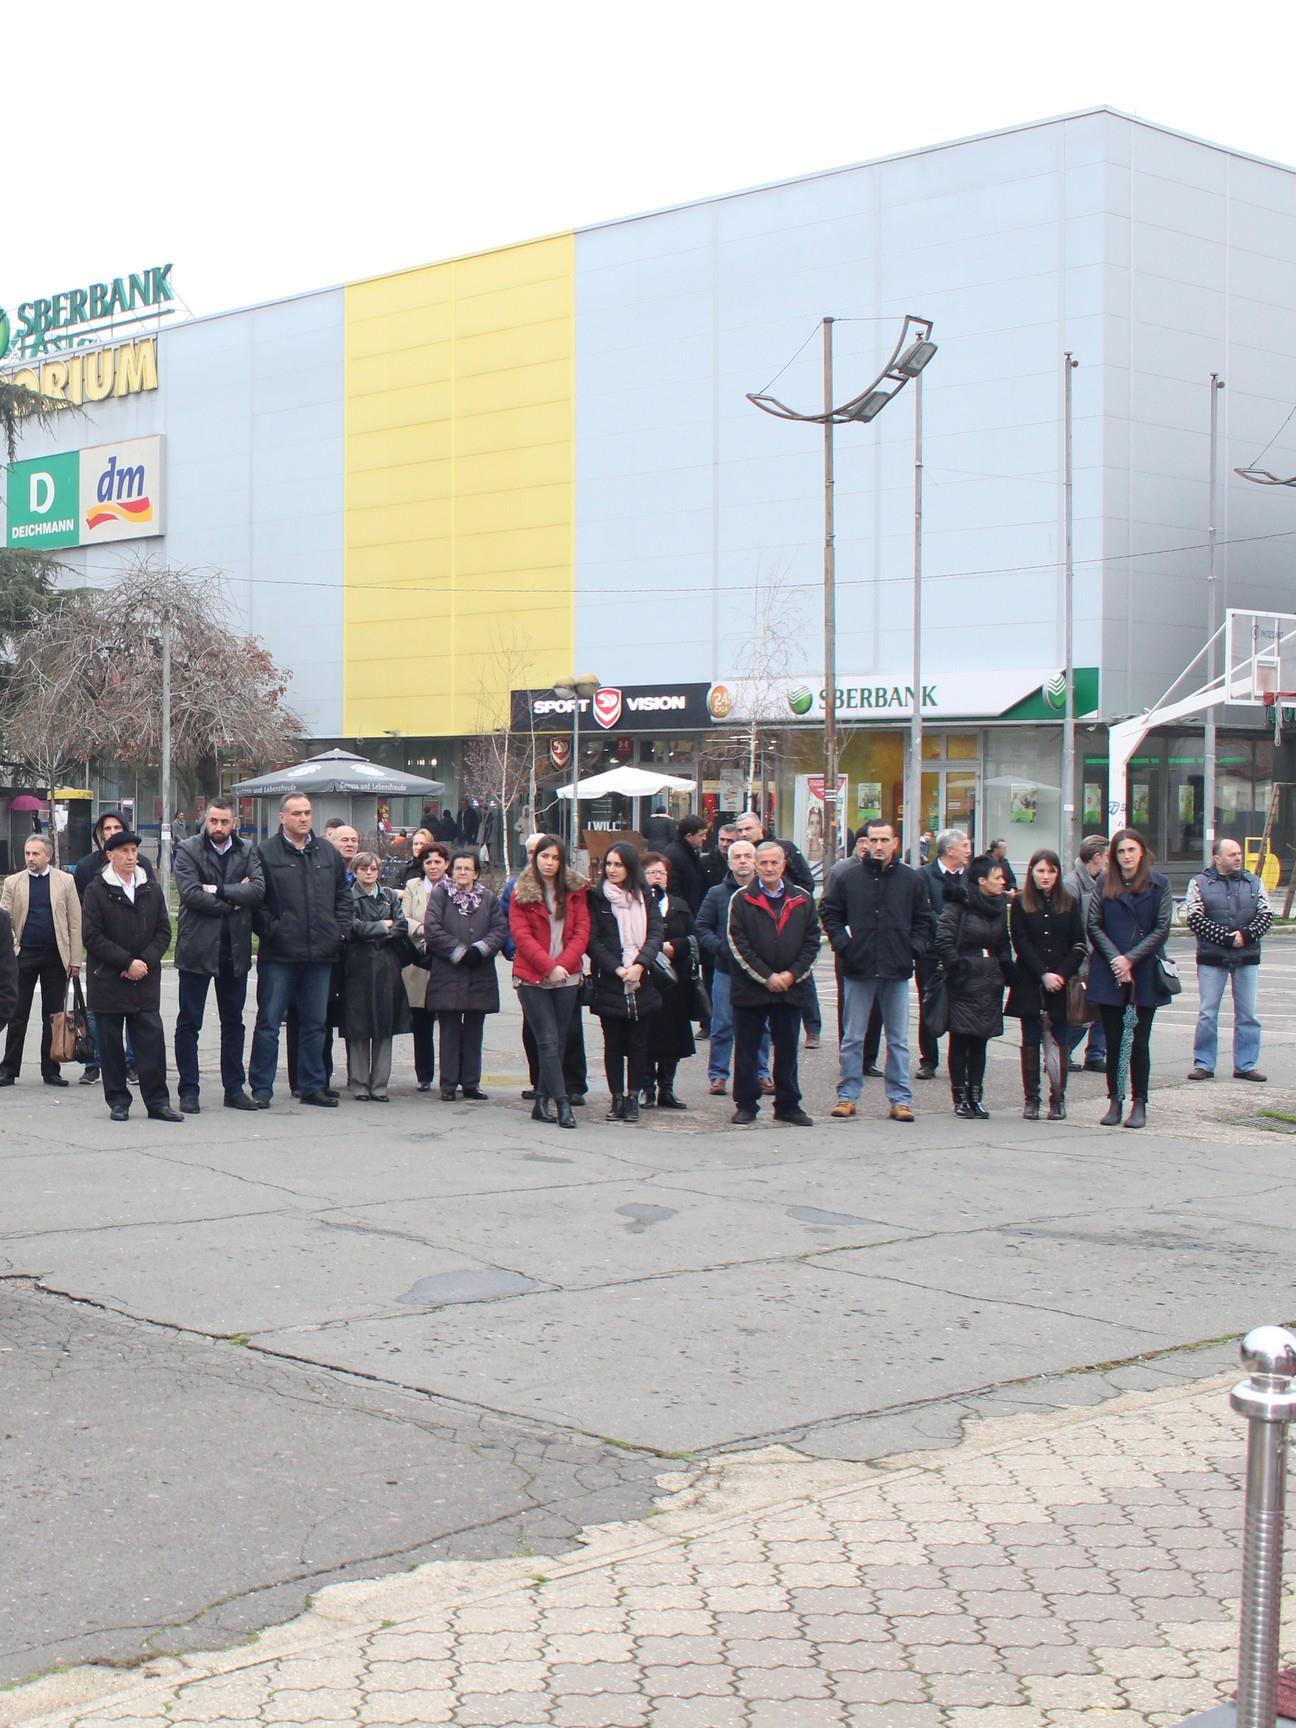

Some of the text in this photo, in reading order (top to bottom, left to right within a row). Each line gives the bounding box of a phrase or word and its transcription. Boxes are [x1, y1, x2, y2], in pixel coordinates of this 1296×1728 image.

[17, 263, 174, 338] SBERBANK
[30, 472, 55, 514] D
[97, 456, 145, 503] dm
[12, 519, 74, 539] DEICHMANN
[534, 696, 687, 714] SPORT VISION
